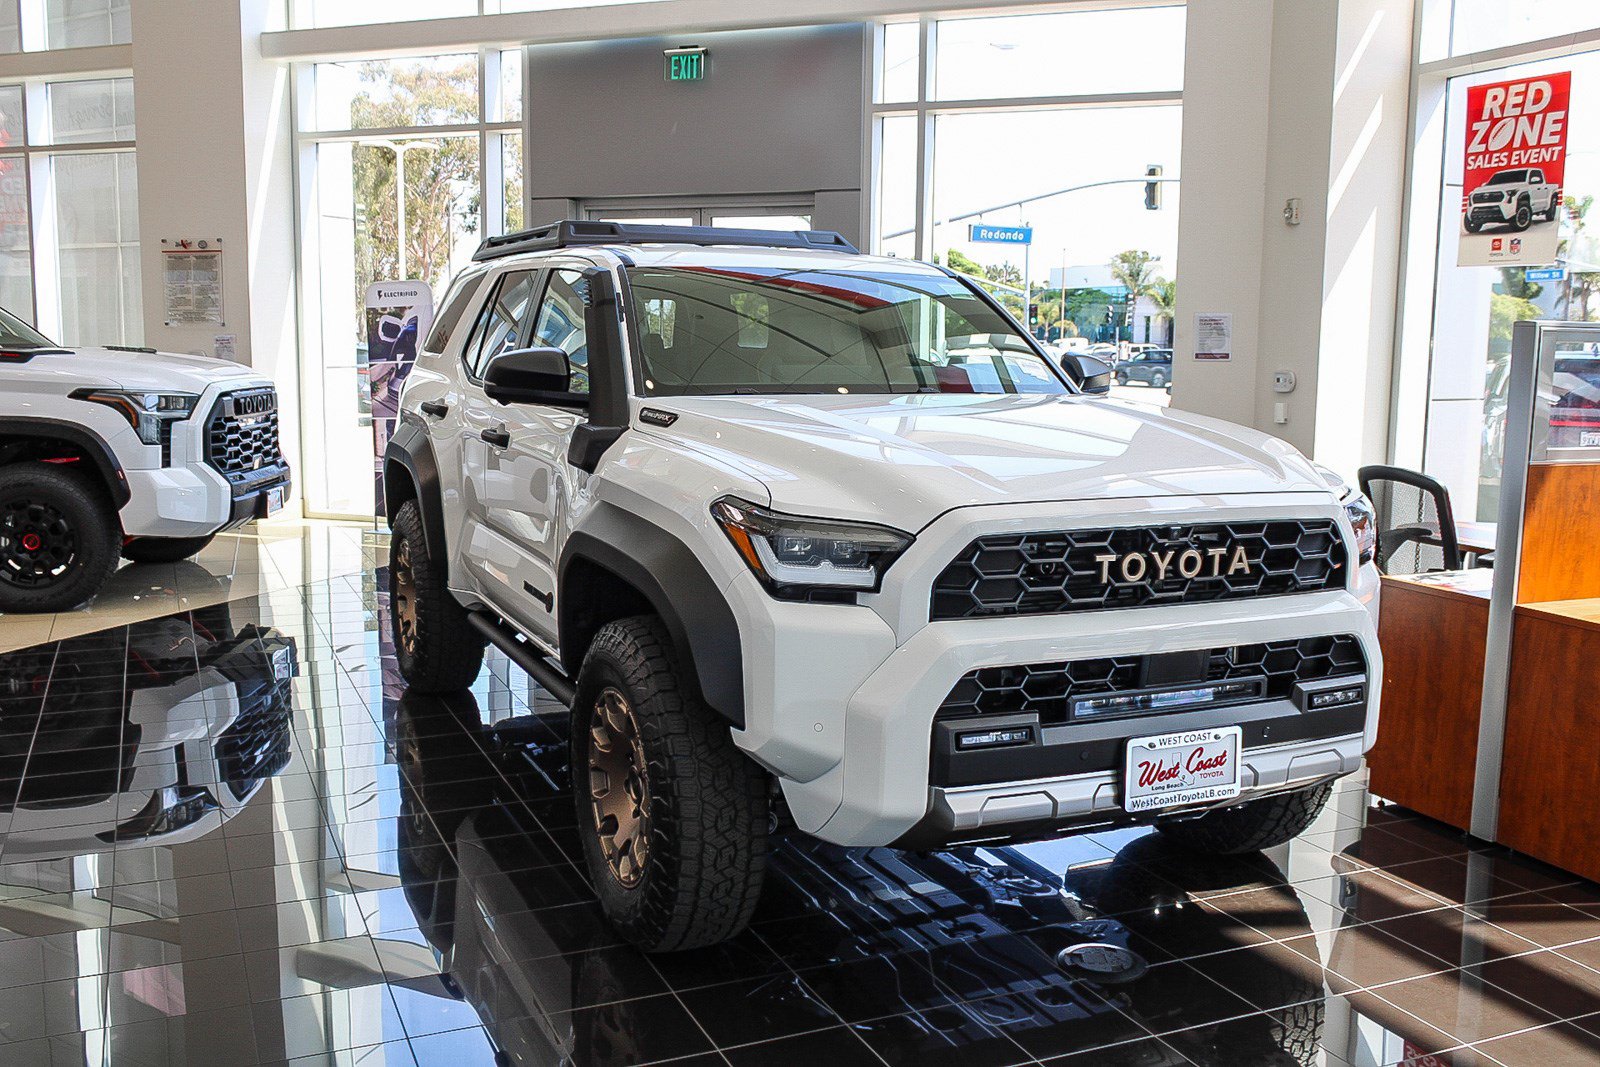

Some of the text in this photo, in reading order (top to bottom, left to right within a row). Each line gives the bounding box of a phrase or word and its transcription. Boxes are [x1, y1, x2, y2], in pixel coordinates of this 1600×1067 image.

[671, 55, 699, 80] EXIT
[1481, 80, 1552, 120] RED
[1467, 111, 1566, 153] ZONE
[1466, 146, 1563, 170] SALES EVENT
[980, 229, 1024, 240] Redondo
[384, 290, 418, 298] ELECTRIFIED
[240, 394, 273, 415] TOYOTA
[1095, 545, 1250, 584] TOYOTA
[1158, 732, 1212, 746] WEST COAST
[1138, 747, 1227, 787] West Coast
[1199, 770, 1224, 779] TOYOTA
[1131, 788, 1235, 809] WestCoastToyotaLB.com
[1151, 784, 1165, 792] Long
